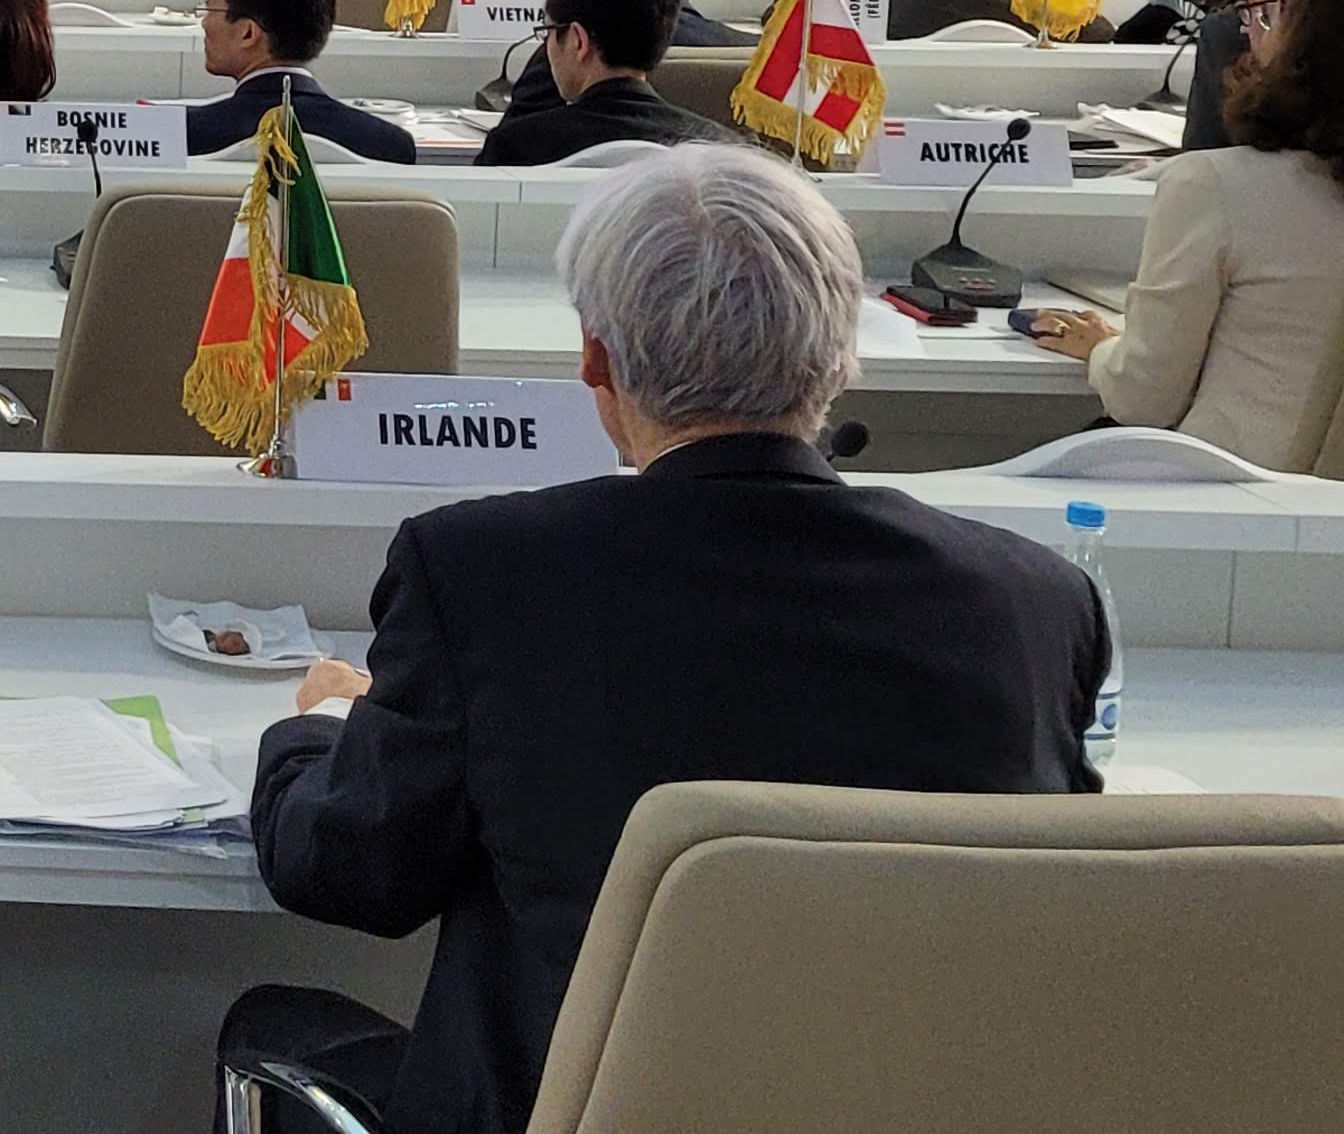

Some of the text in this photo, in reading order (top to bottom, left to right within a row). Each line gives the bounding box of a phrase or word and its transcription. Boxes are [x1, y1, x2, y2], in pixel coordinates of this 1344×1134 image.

[487, 6, 546, 22] VIETNA
[57, 110, 127, 128] BOSNIE
[25, 137, 160, 157] HERZEGOVINE
[920, 142, 1030, 164] AUTRICHE
[378, 412, 537, 451] IRLANDE
